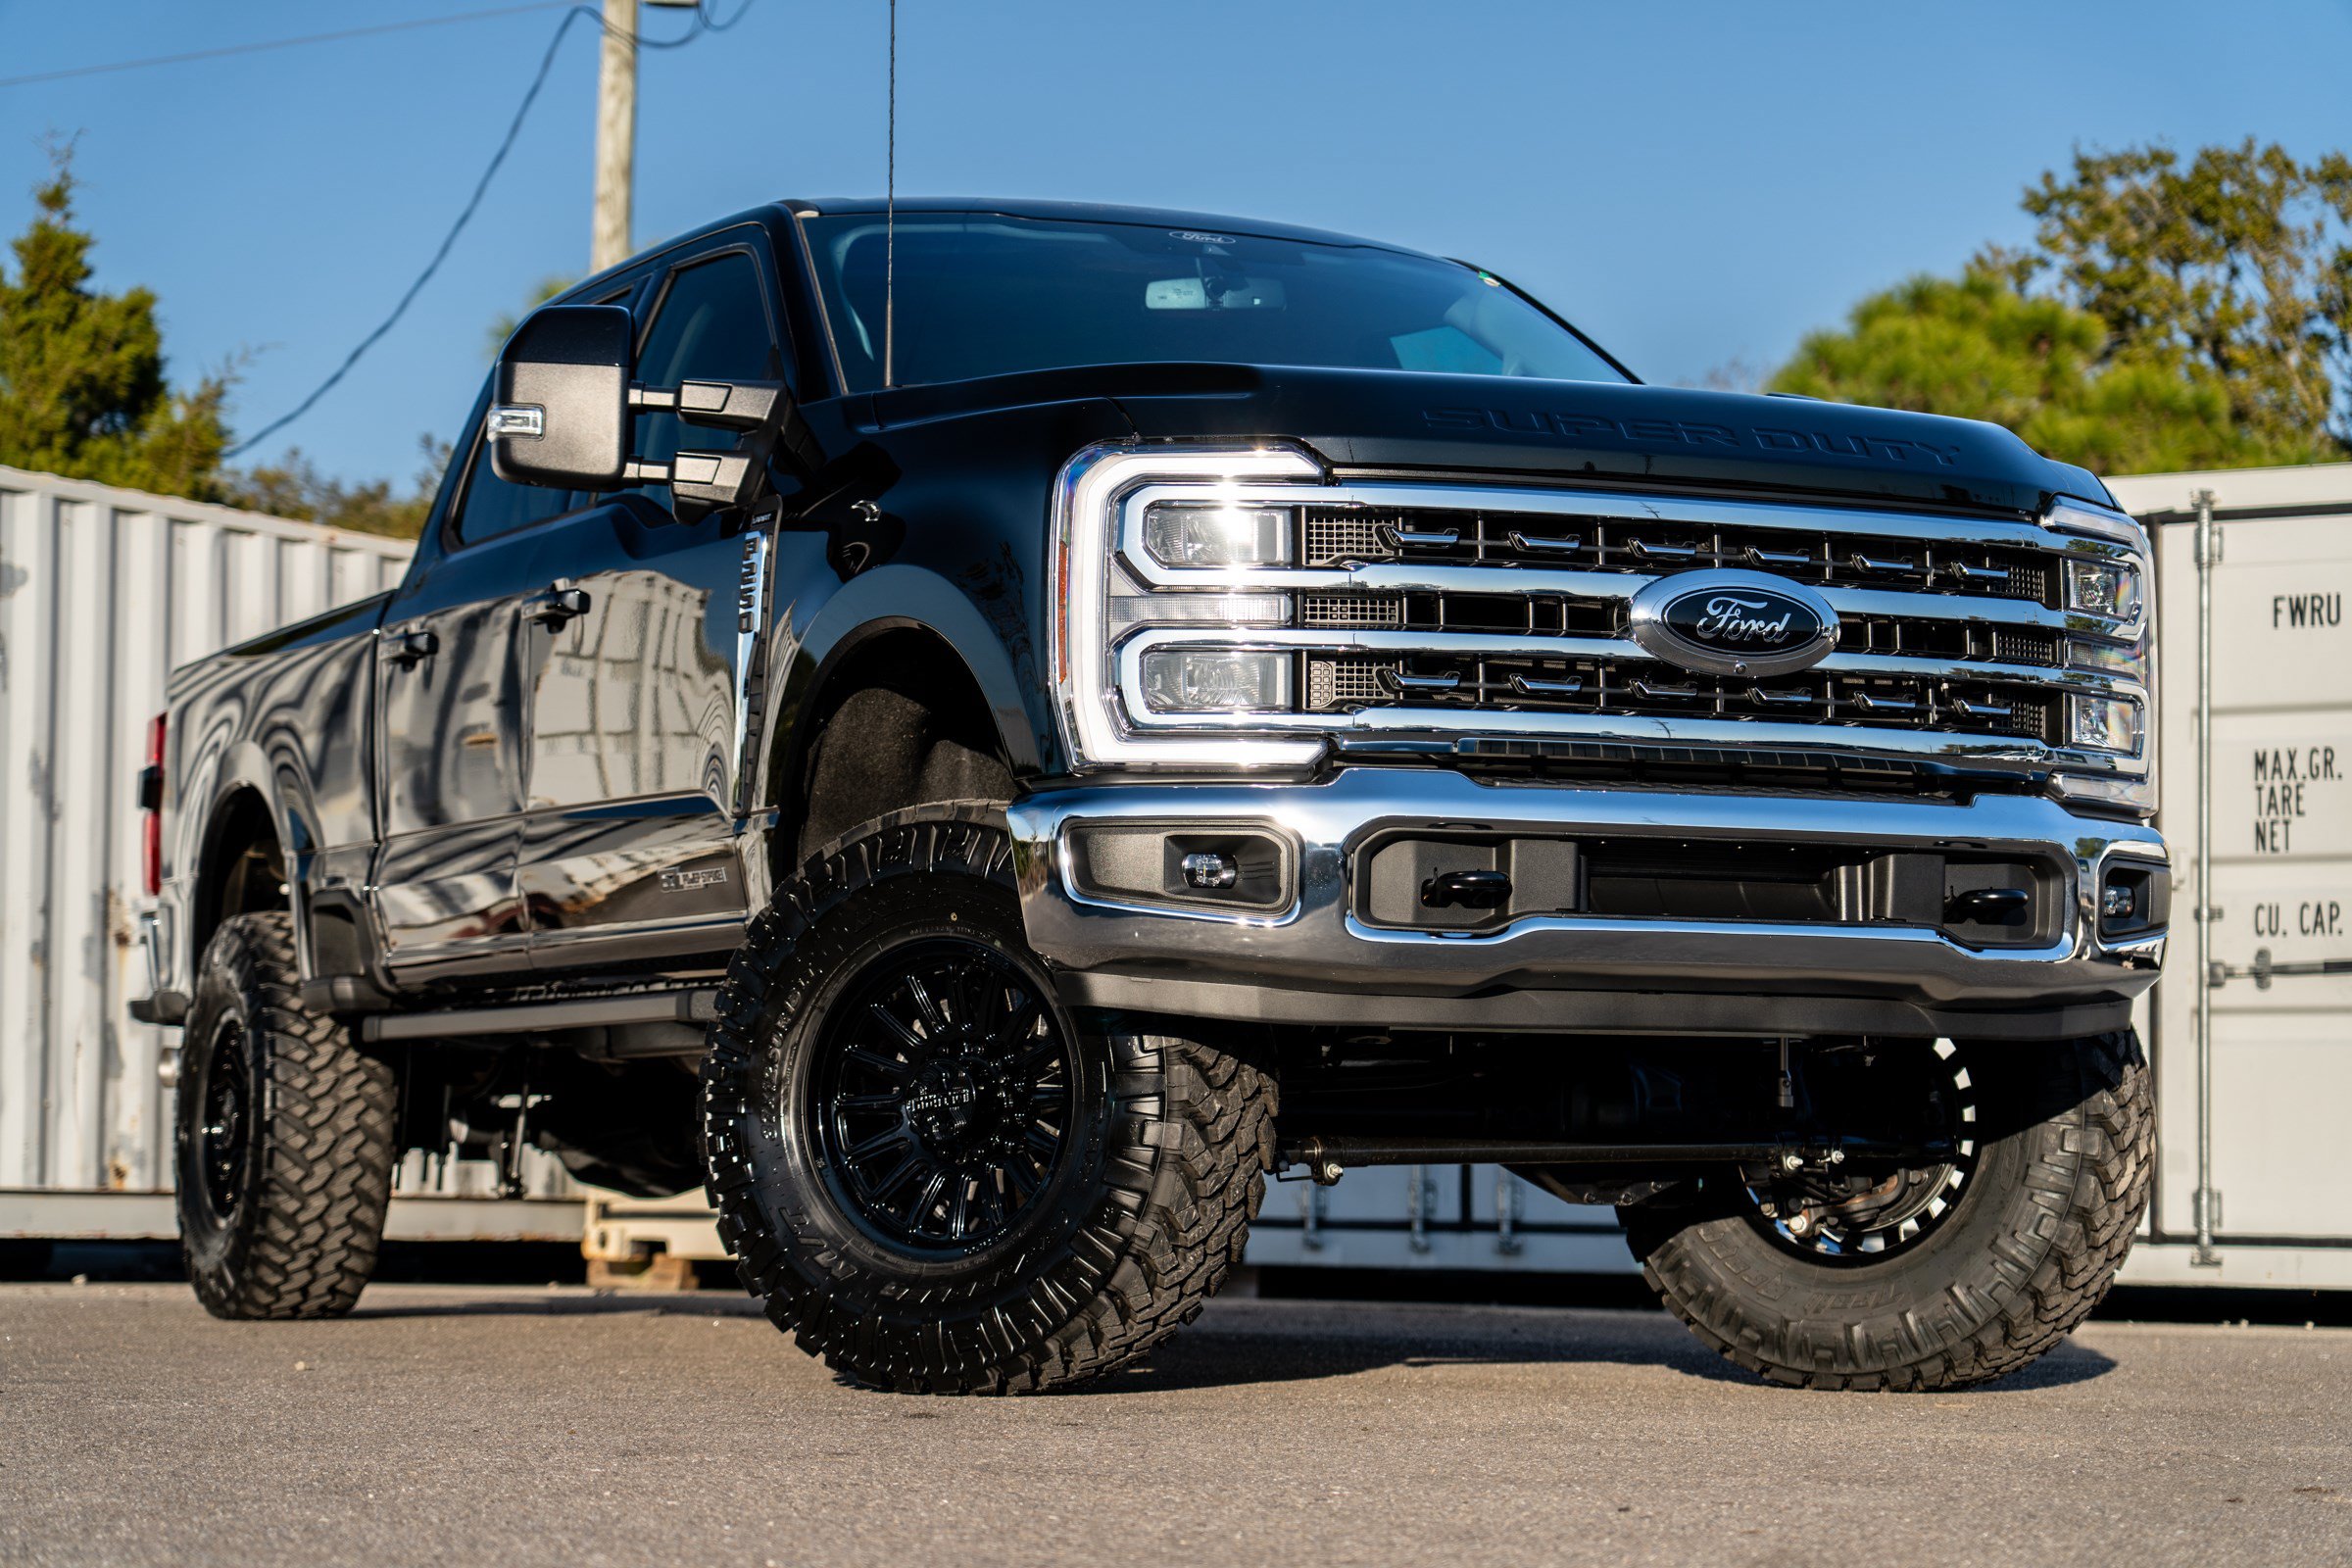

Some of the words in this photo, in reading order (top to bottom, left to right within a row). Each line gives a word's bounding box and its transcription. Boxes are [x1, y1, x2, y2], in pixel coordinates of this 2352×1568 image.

[1182, 231, 1224, 243] Ford
[1421, 408, 1740, 447] SUPER
[1752, 427, 1961, 466] DUTY
[1696, 597, 1792, 644] Ford
[2273, 593, 2342, 629] FWRU
[2255, 784, 2306, 816] TARE
[2255, 820, 2291, 853] NET
[2255, 903, 2287, 936] CU.
[2299, 901, 2343, 936] CAP.
[779, 1202, 858, 1283] M/T
